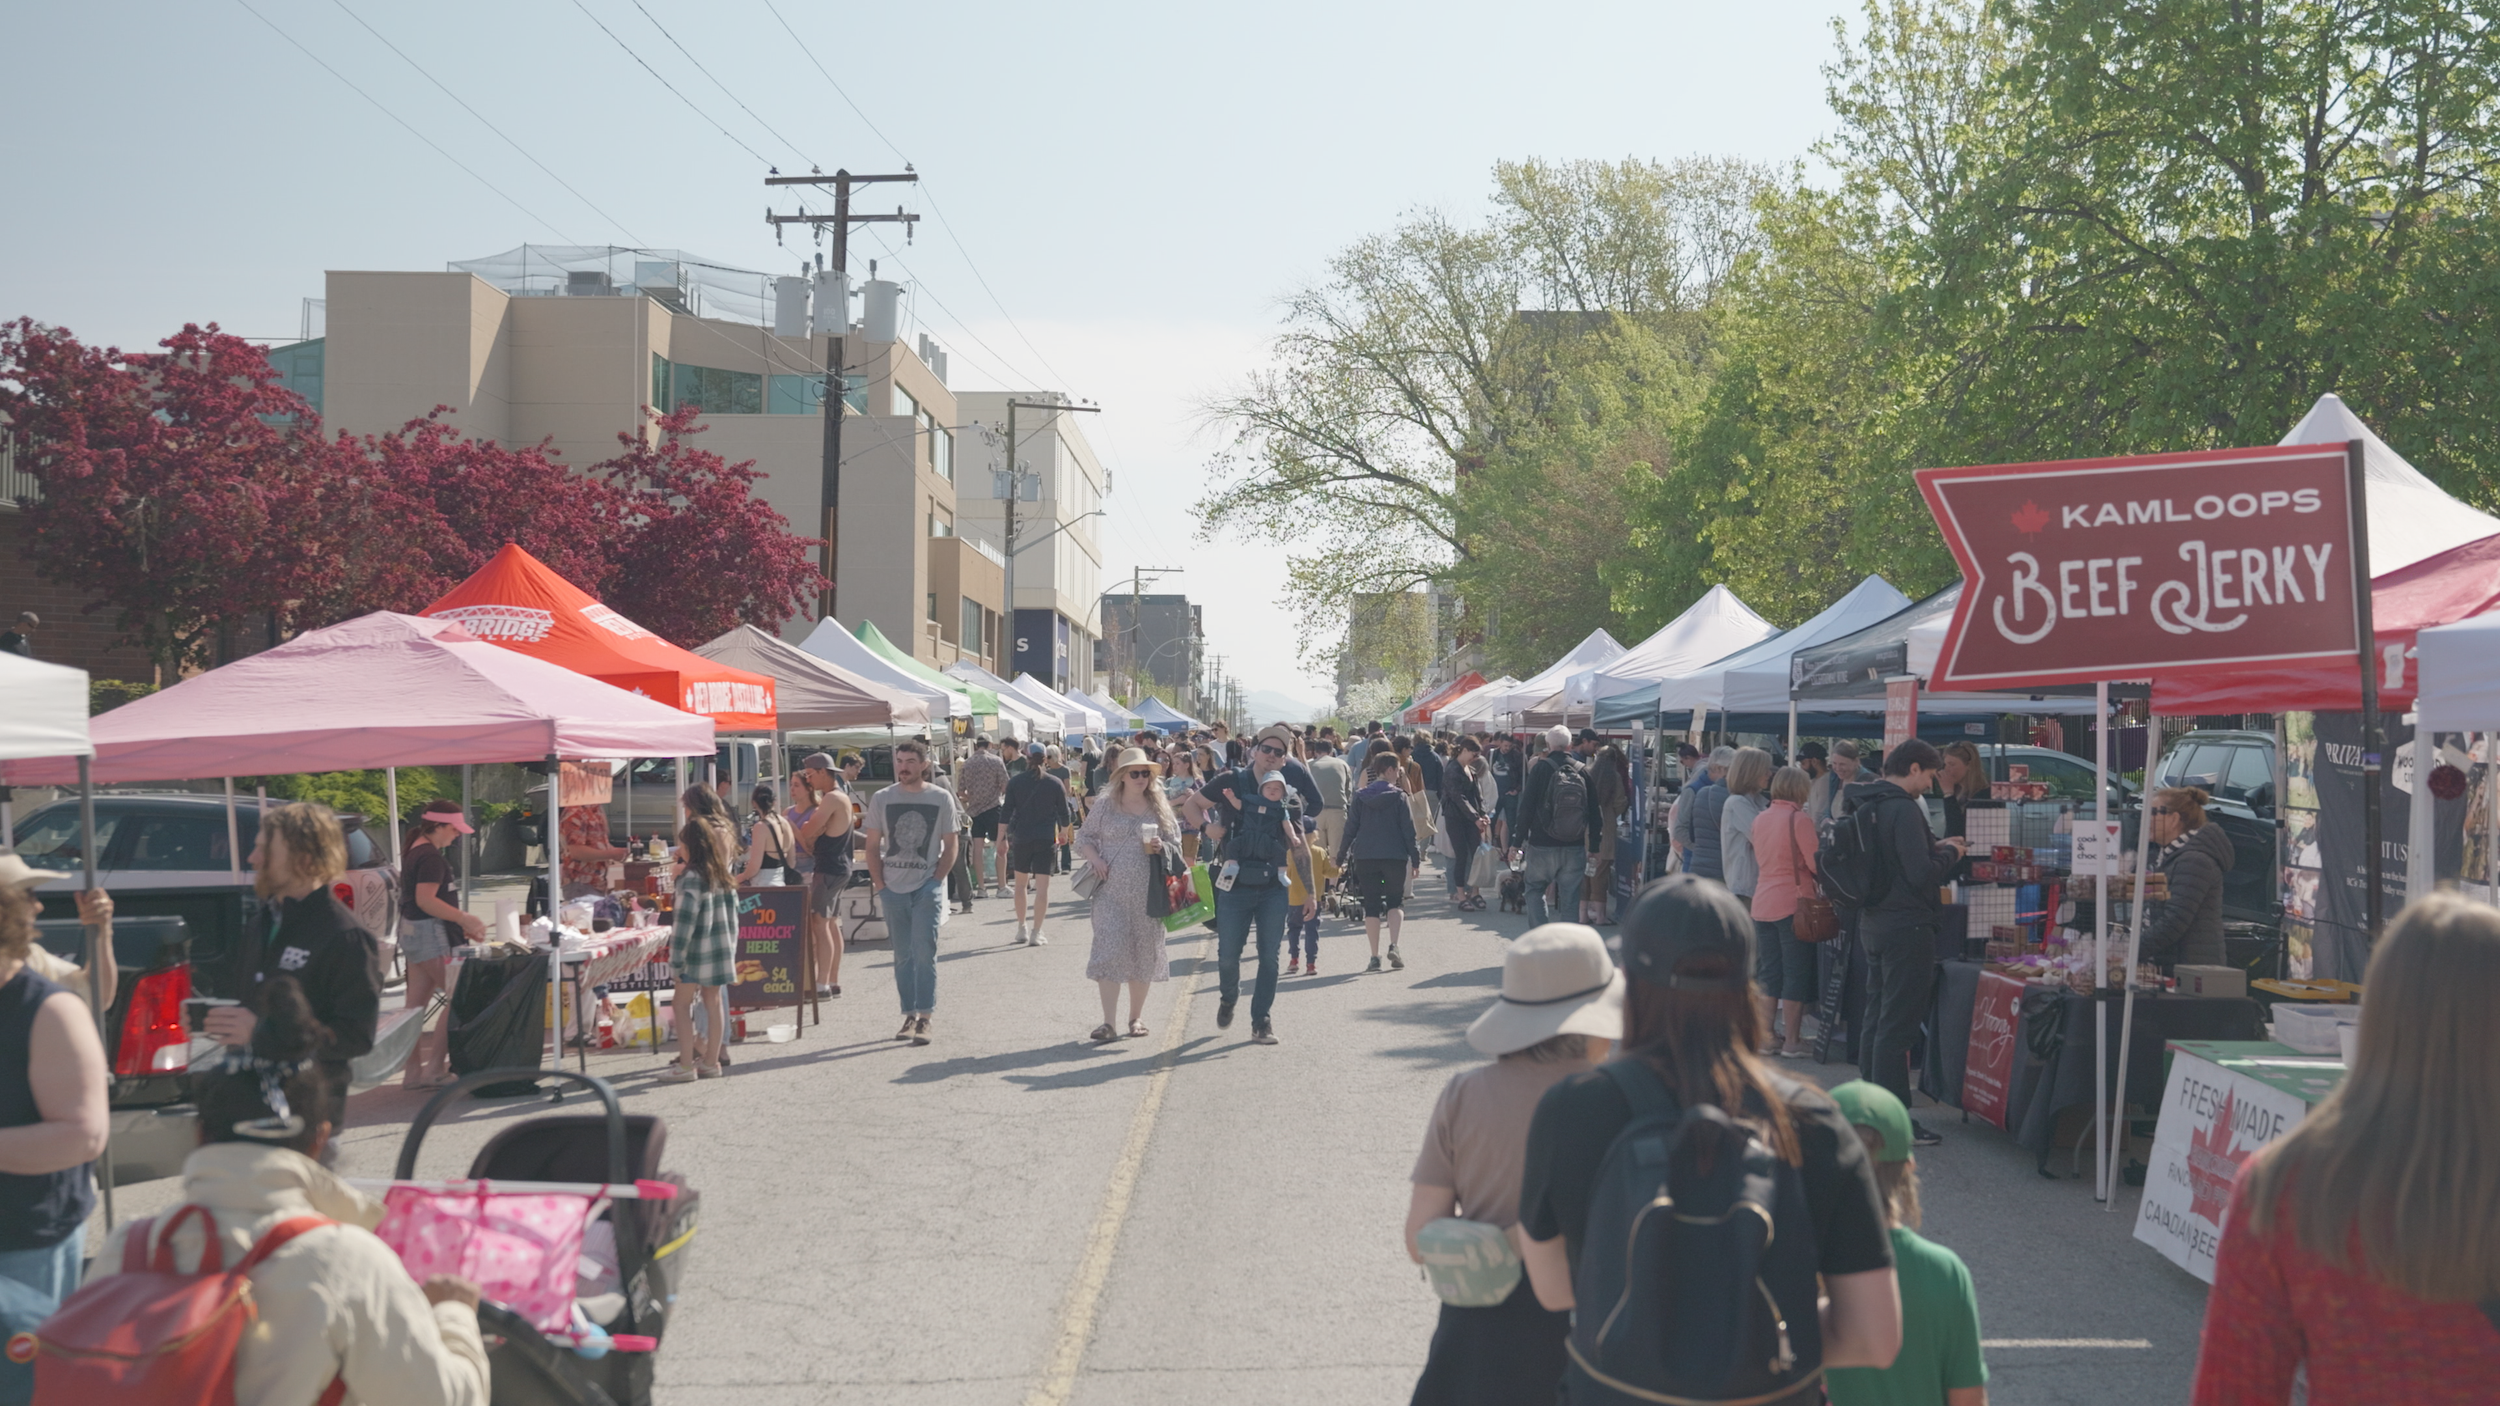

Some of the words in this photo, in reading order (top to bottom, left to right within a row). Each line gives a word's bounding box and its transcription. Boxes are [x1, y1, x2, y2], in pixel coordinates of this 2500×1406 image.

[2062, 488, 2322, 529] KAMLOOPS
[1993, 551, 2143, 644] BEEF
[2150, 540, 2332, 634] JERKY
[465, 619, 554, 638] BRIDGE
[2077, 834, 2110, 843] cooks
[2077, 851, 2118, 860] chocate
[738, 893, 762, 914] GET
[745, 941, 780, 954] HERE
[772, 967, 788, 981] $4
[763, 980, 795, 993] each
